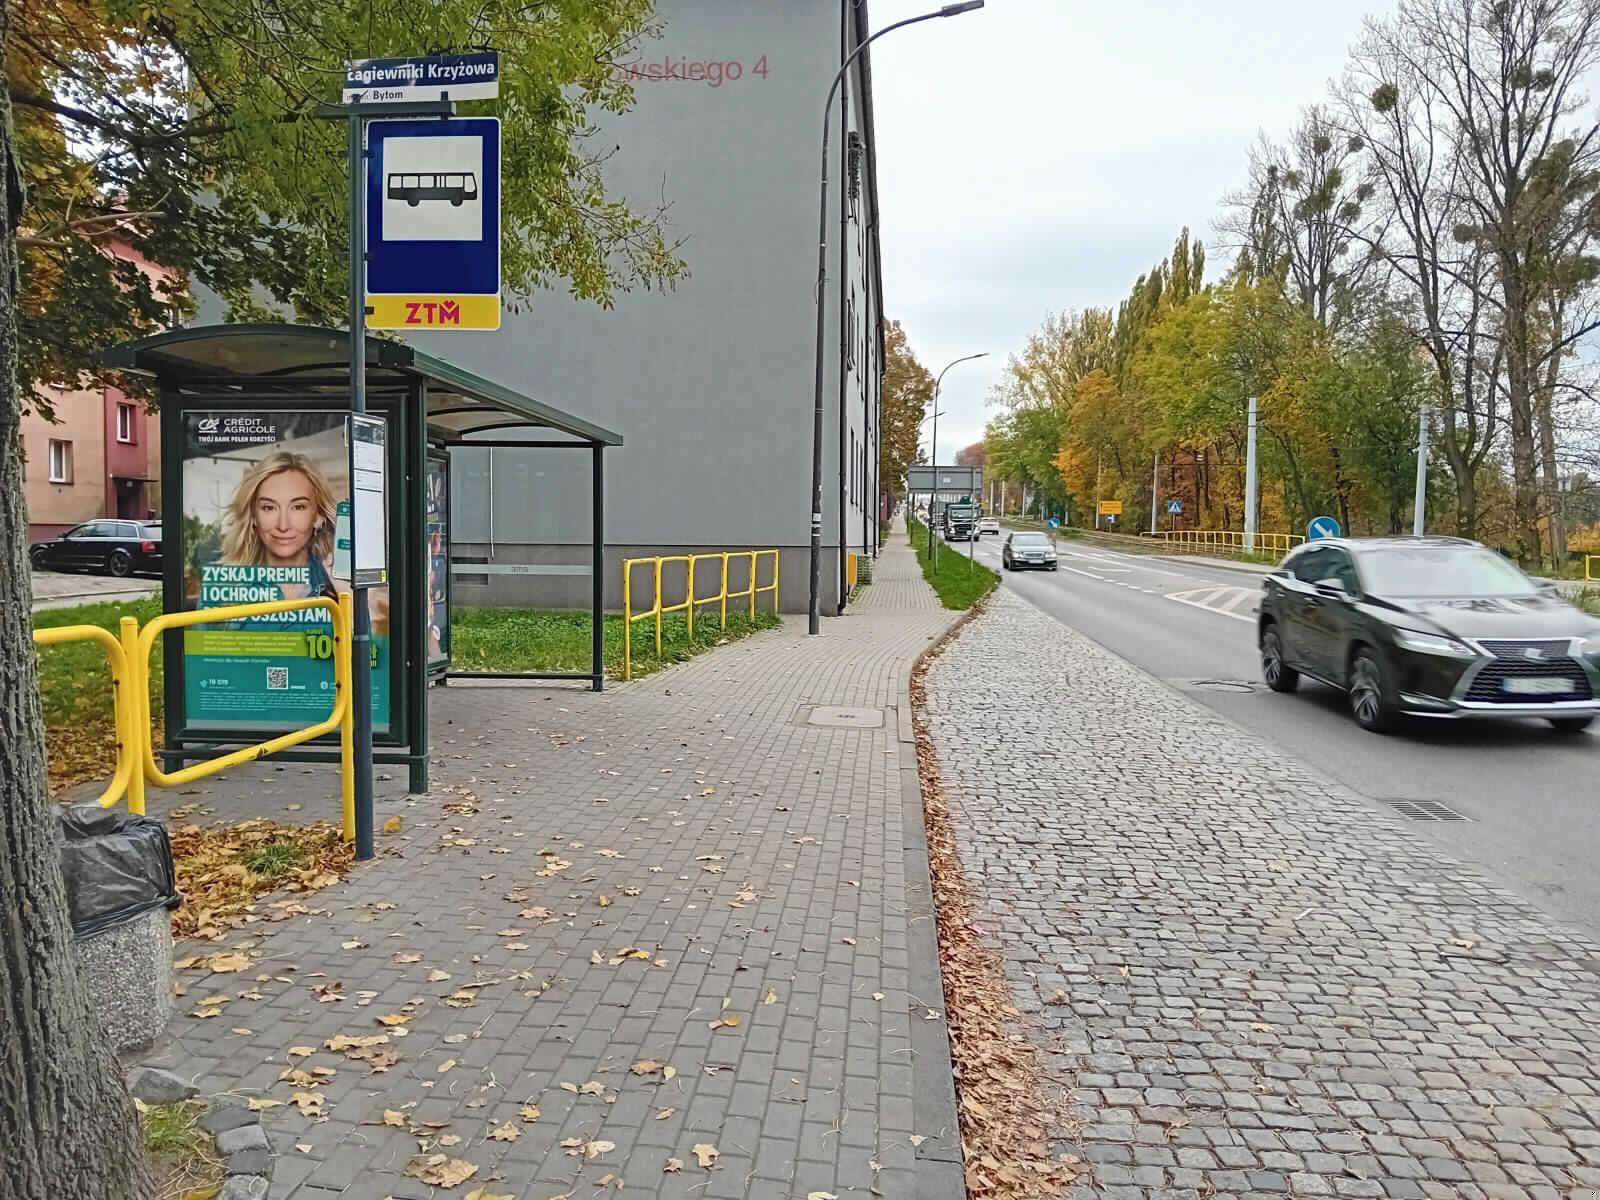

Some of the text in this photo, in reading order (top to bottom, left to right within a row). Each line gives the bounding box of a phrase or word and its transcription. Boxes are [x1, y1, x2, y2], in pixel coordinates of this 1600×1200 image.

[428, 61, 495, 80] Krzyżowa
[618, 55, 769, 87] wskiego 4
[373, 91, 403, 100] Bytom
[405, 300, 460, 325] ZTM
[223, 417, 262, 426] CRÉDIT
[223, 425, 276, 433] AGRICOLE
[202, 567, 310, 584] ZYSKAJ PREMIĘ
[203, 587, 208, 601] I
